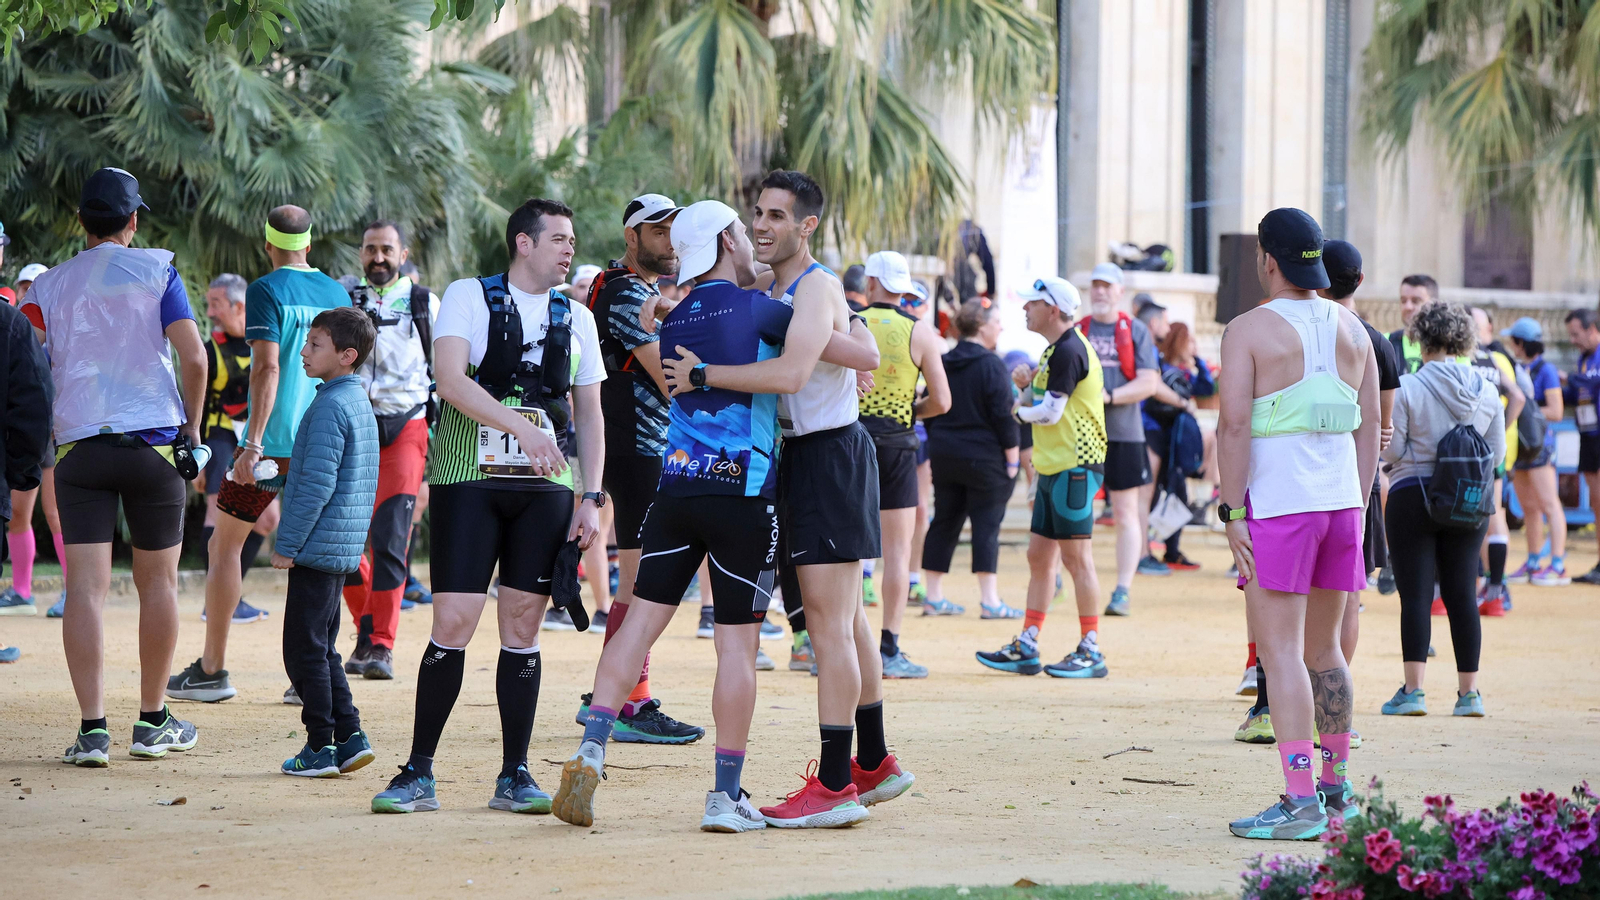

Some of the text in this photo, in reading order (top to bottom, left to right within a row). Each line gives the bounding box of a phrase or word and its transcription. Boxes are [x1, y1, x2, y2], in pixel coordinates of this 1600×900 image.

[689, 315, 705, 323] Para
[709, 308, 733, 318] Todos
[693, 472, 711, 480] Para
[715, 475, 740, 485] Todos
[765, 514, 780, 564] WONG
[734, 803, 752, 820] HOKA
